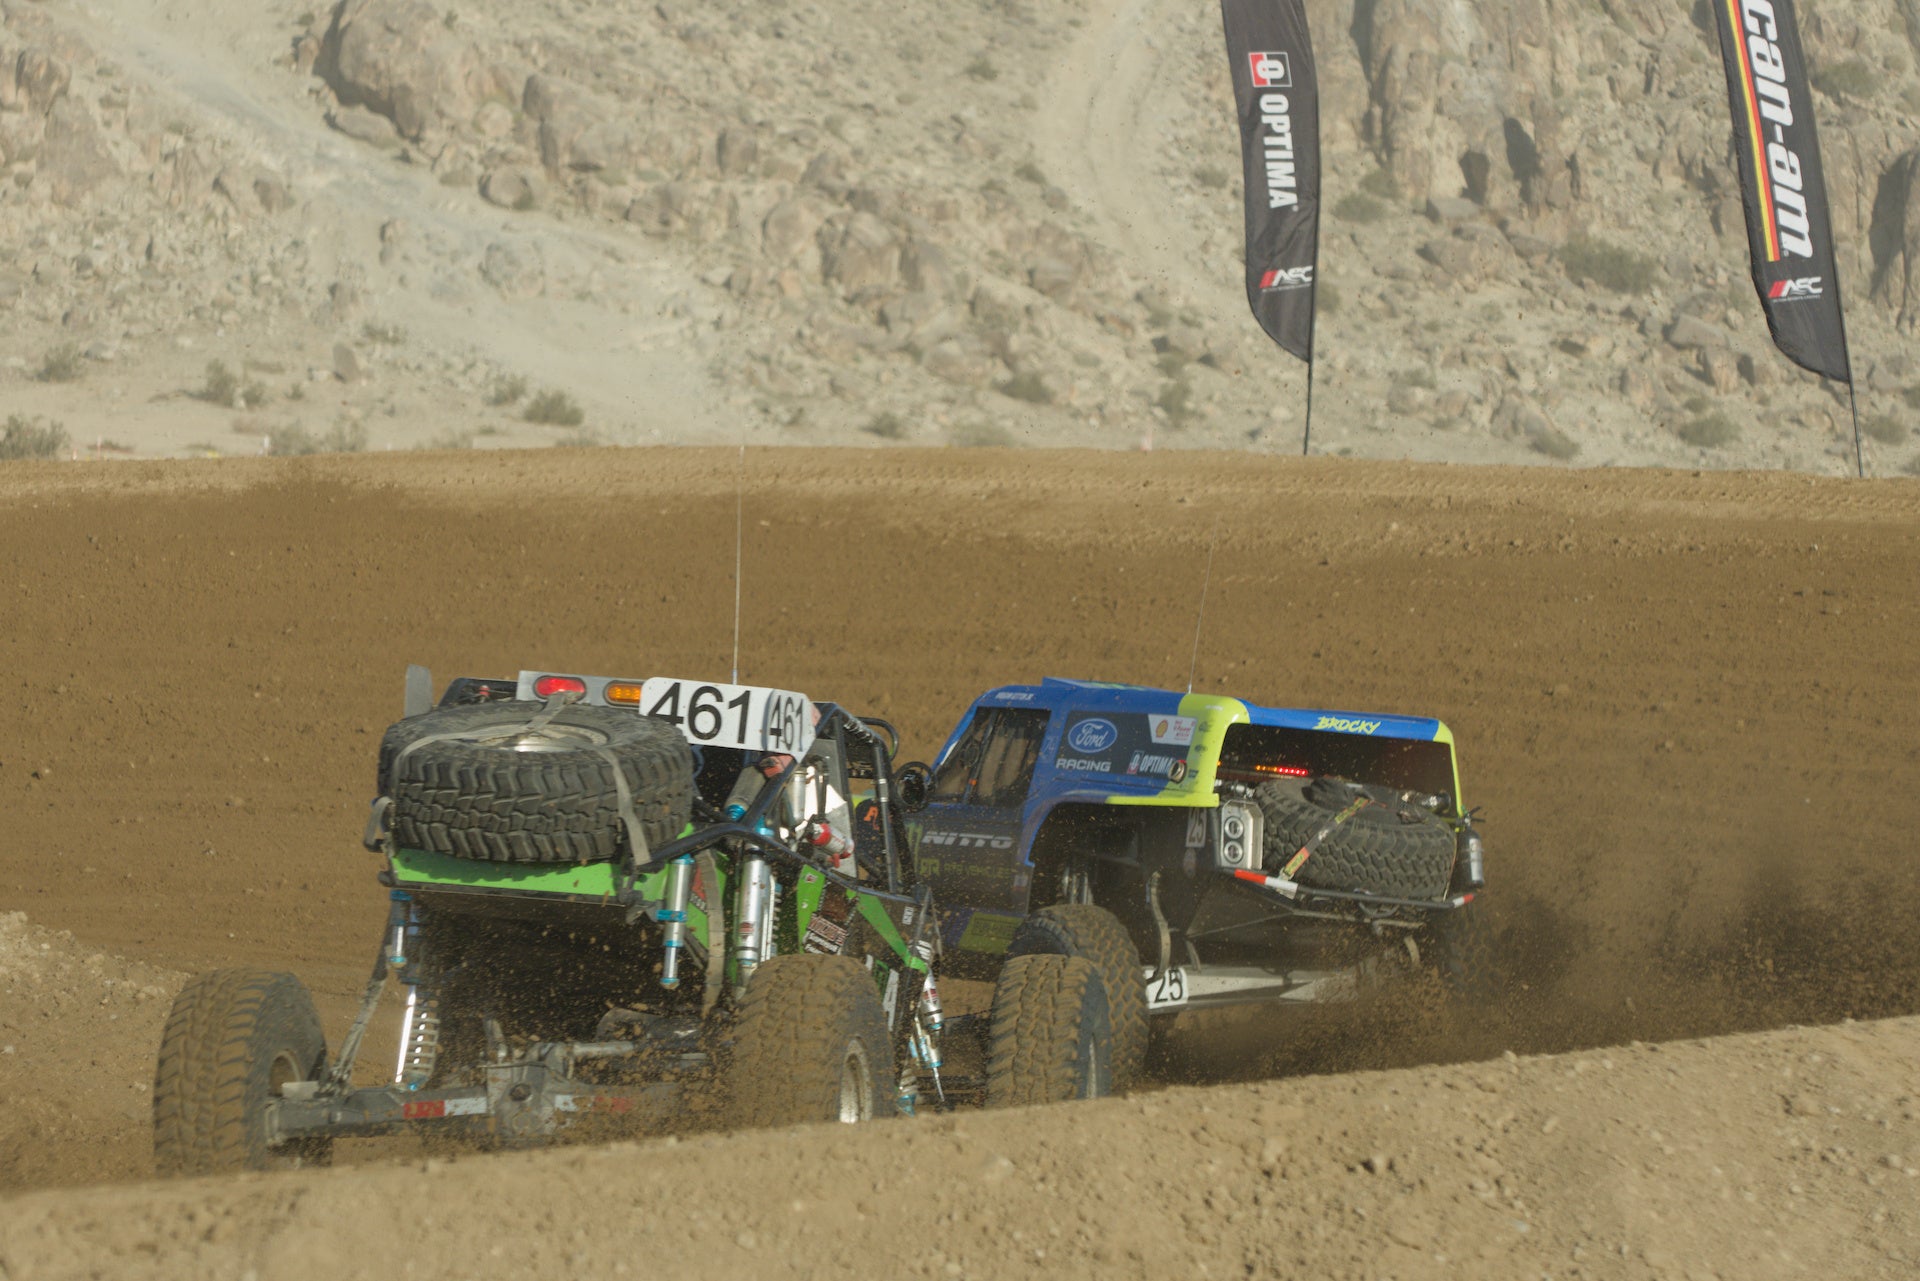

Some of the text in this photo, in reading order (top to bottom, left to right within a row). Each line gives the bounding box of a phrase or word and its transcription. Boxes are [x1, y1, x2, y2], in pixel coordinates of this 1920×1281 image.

[1742, 0, 1813, 258] can-am
[1259, 94, 1298, 209] OPTIMA
[648, 682, 752, 745] 461
[769, 695, 805, 752] 461
[1313, 716, 1381, 735] BROCKY
[1075, 722, 1109, 749] Ford
[1055, 757, 1112, 773] RACING
[921, 831, 1013, 850] NITTO
[1154, 969, 1184, 1004] 25
